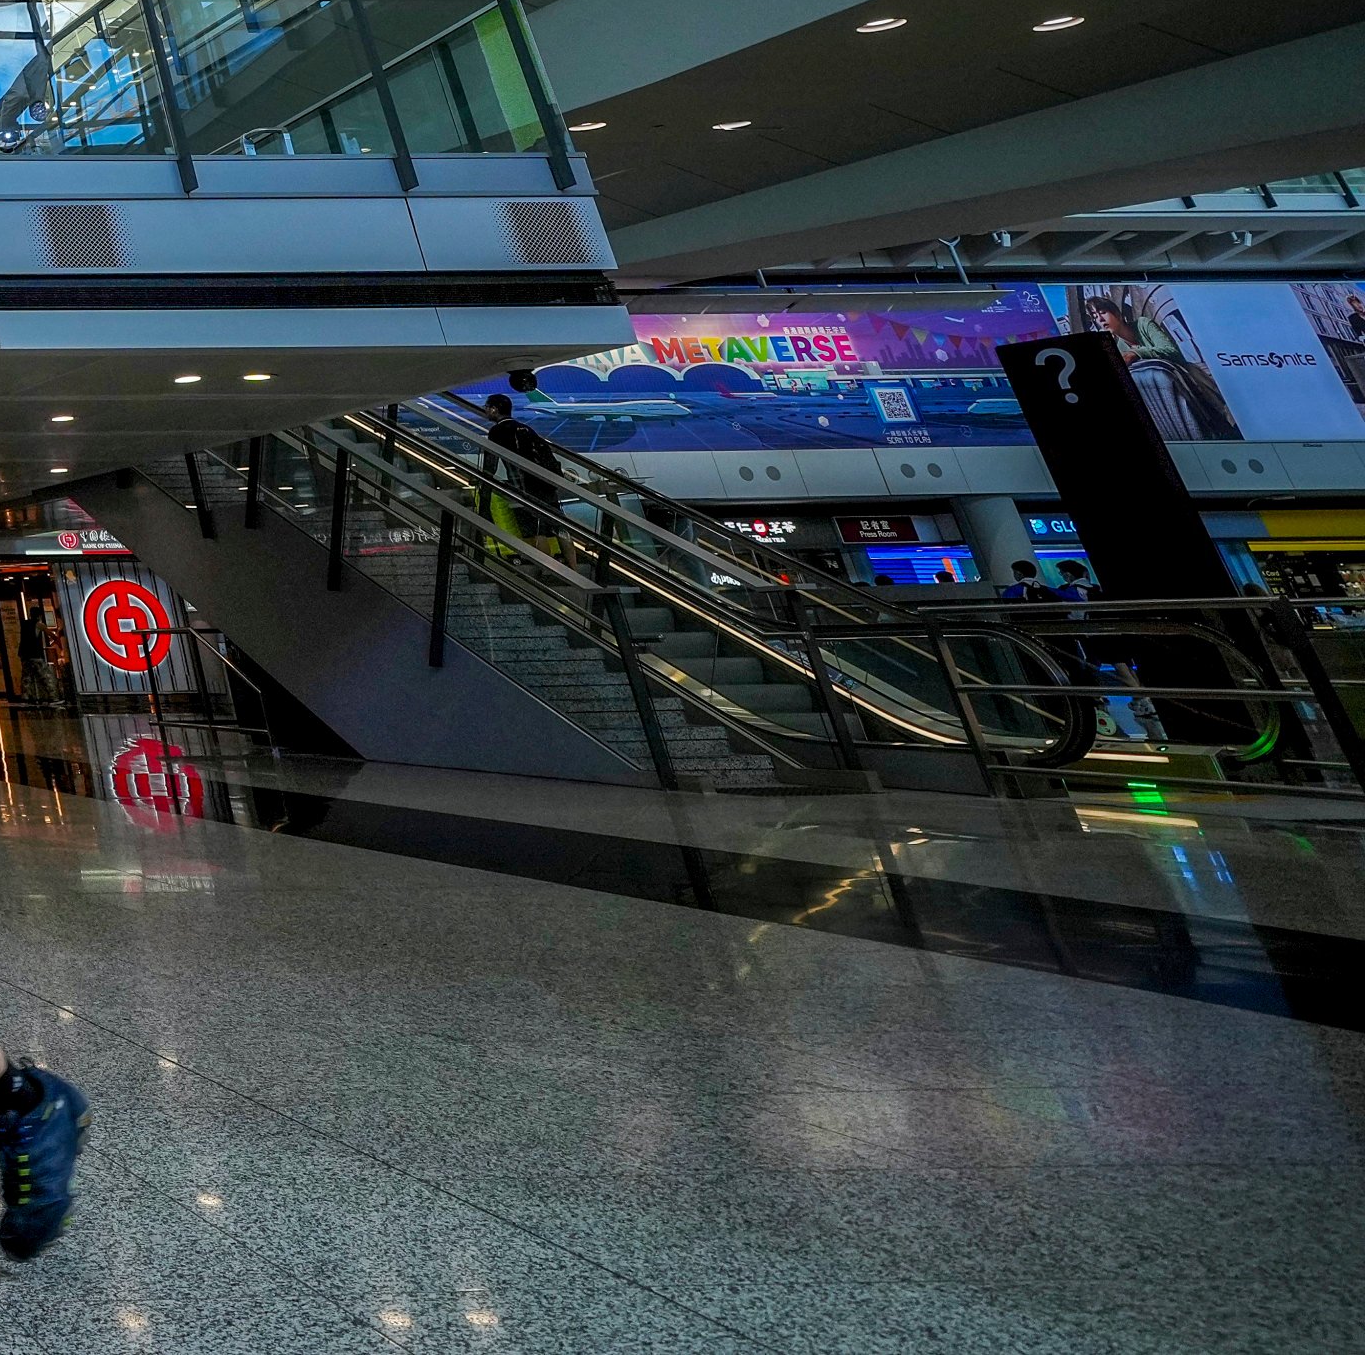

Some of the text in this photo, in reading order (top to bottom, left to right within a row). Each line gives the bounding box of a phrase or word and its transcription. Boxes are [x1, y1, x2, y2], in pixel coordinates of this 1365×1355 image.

[650, 335, 858, 364] METAVERSE
[1216, 352, 1317, 368] Samsonite
[859, 520, 890, 530] 記者室
[859, 530, 897, 538] Press Room
